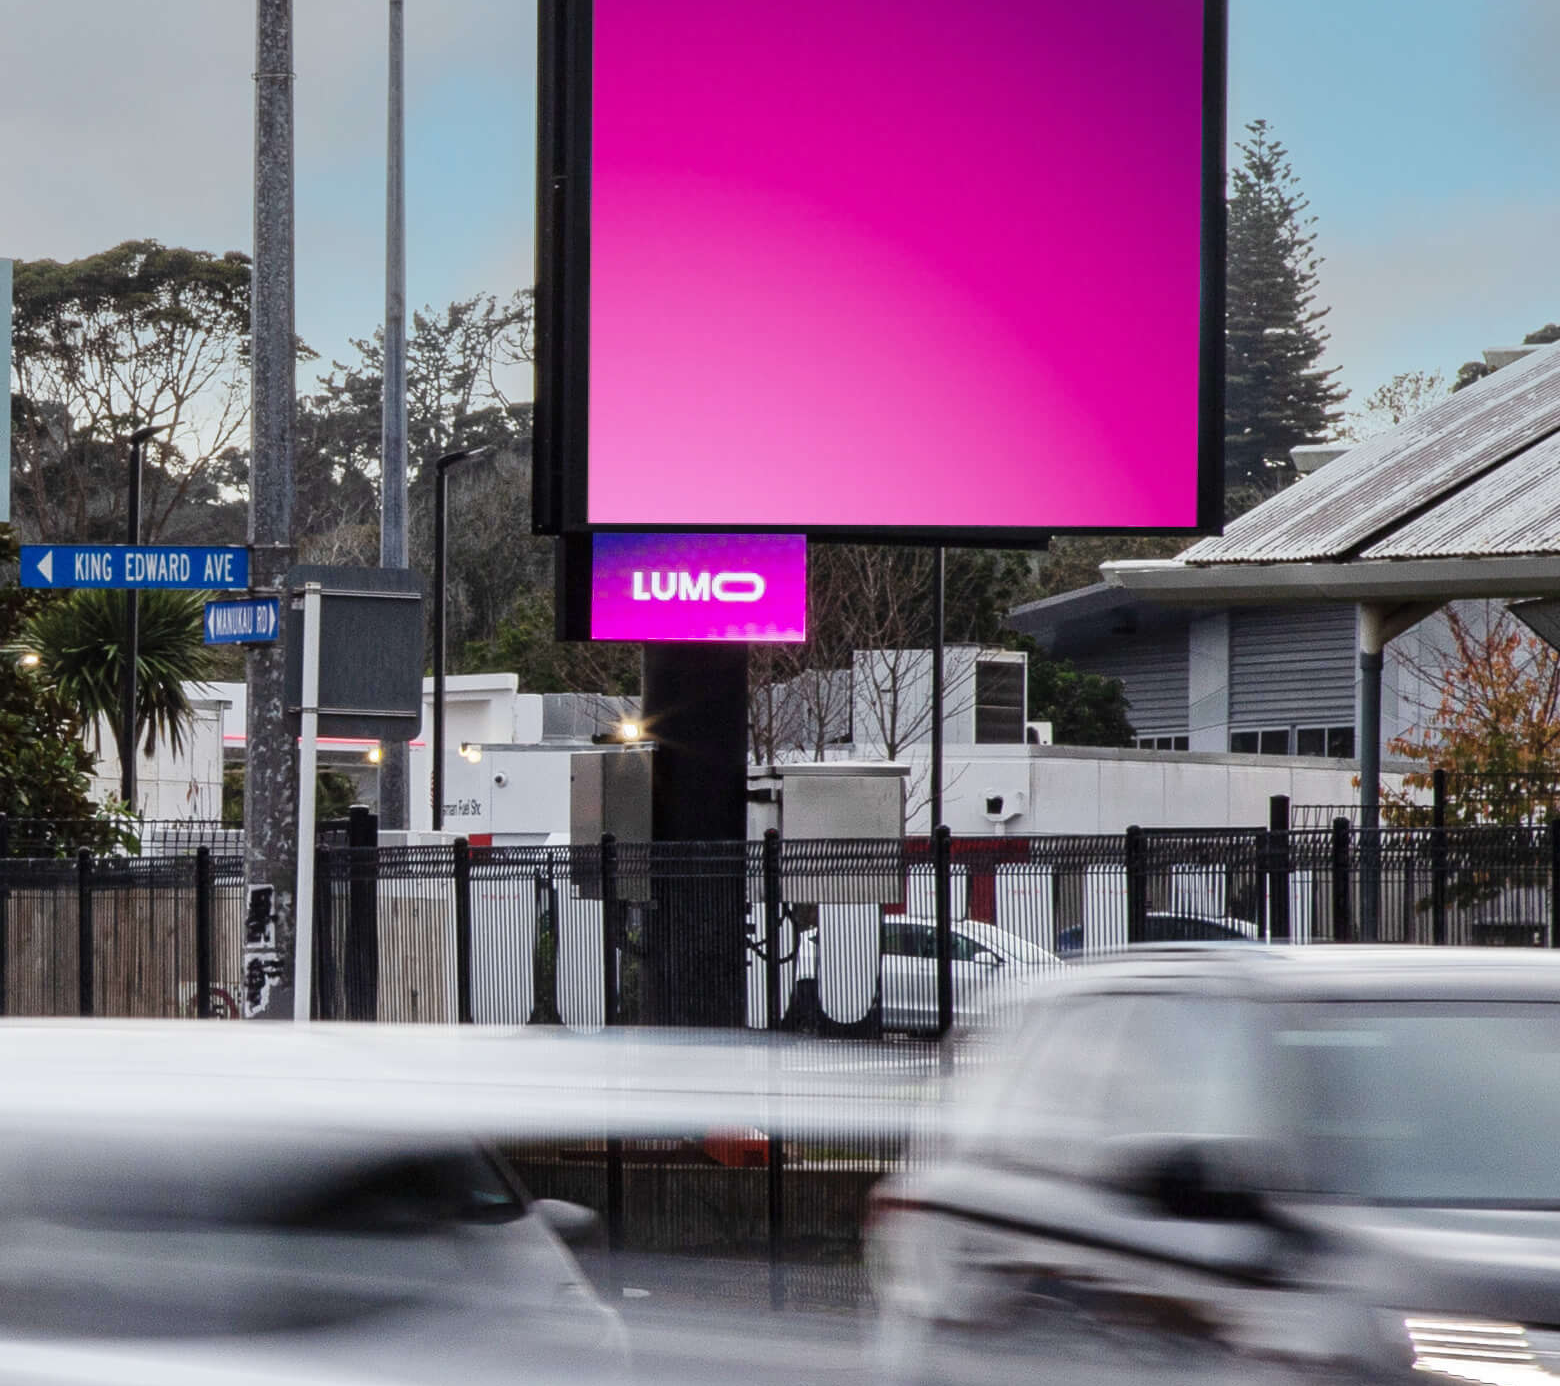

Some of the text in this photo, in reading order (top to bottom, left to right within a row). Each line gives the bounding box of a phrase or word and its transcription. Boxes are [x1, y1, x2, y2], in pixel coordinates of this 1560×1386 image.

[75, 553, 234, 582] KING EDWARD AVE
[633, 571, 765, 601] LUMO
[216, 605, 268, 636] MANUKAU RD
